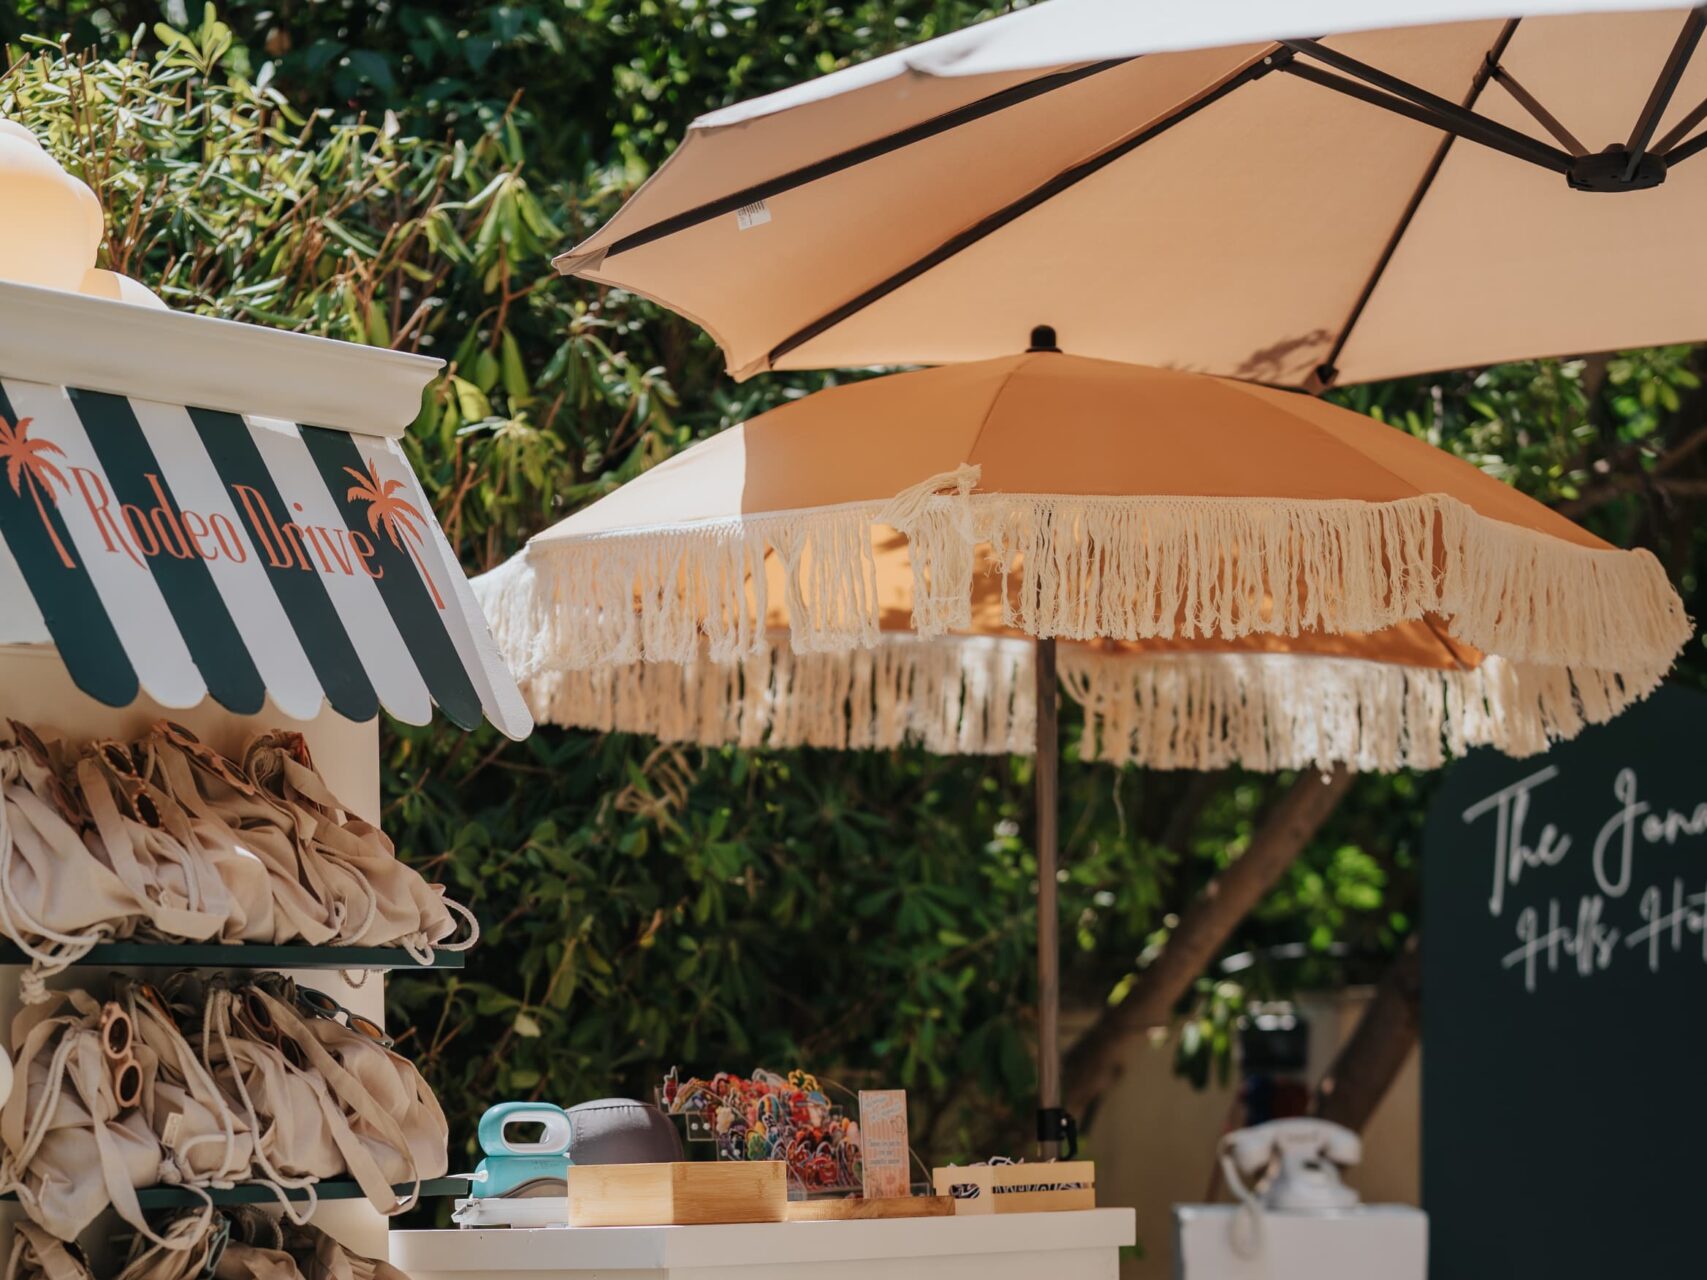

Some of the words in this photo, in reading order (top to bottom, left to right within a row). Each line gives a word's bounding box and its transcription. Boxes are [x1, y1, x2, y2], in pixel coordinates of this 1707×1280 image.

[67, 467, 248, 569] Rodeo
[232, 485, 384, 580] Drive
[1462, 764, 1572, 916] The
